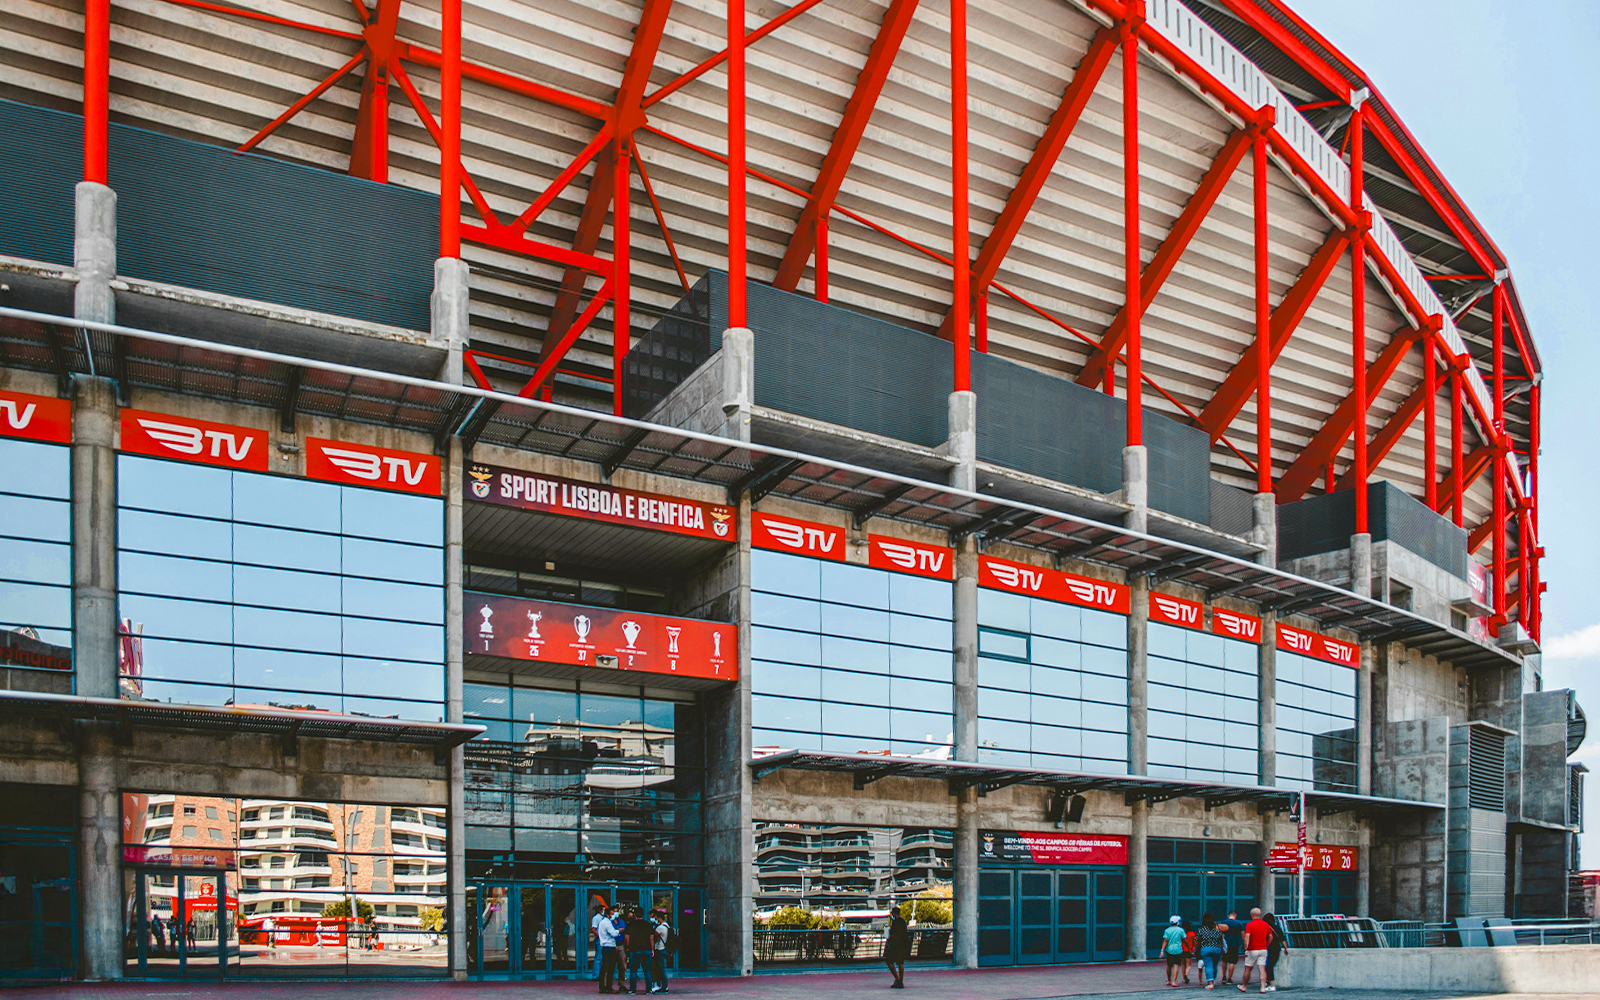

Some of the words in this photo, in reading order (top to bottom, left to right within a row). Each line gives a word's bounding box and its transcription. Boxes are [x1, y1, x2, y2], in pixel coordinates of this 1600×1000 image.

[137, 418, 254, 462] BTV
[320, 446, 427, 486] BTV
[500, 473, 559, 506] SPORT
[562, 483, 622, 517] LISBOA
[625, 495, 635, 519] E
[638, 497, 705, 530] BENFICA
[761, 518, 837, 553] BTV
[877, 541, 945, 572] BTV
[985, 561, 1043, 591] BTV
[1065, 578, 1117, 606] BTV
[1154, 597, 1198, 624] BTV
[1218, 613, 1257, 637] BTV
[484, 639, 489, 651] 1
[1280, 628, 1313, 652] BTV
[1323, 640, 1353, 662] BTV
[577, 649, 587, 661] 37
[628, 654, 633, 666] 2
[670, 659, 676, 671] 8
[714, 664, 720, 675] 7
[152, 853, 180, 861] CASAS
[1321, 855, 1331, 869] 19
[1341, 855, 1351, 869] 20
